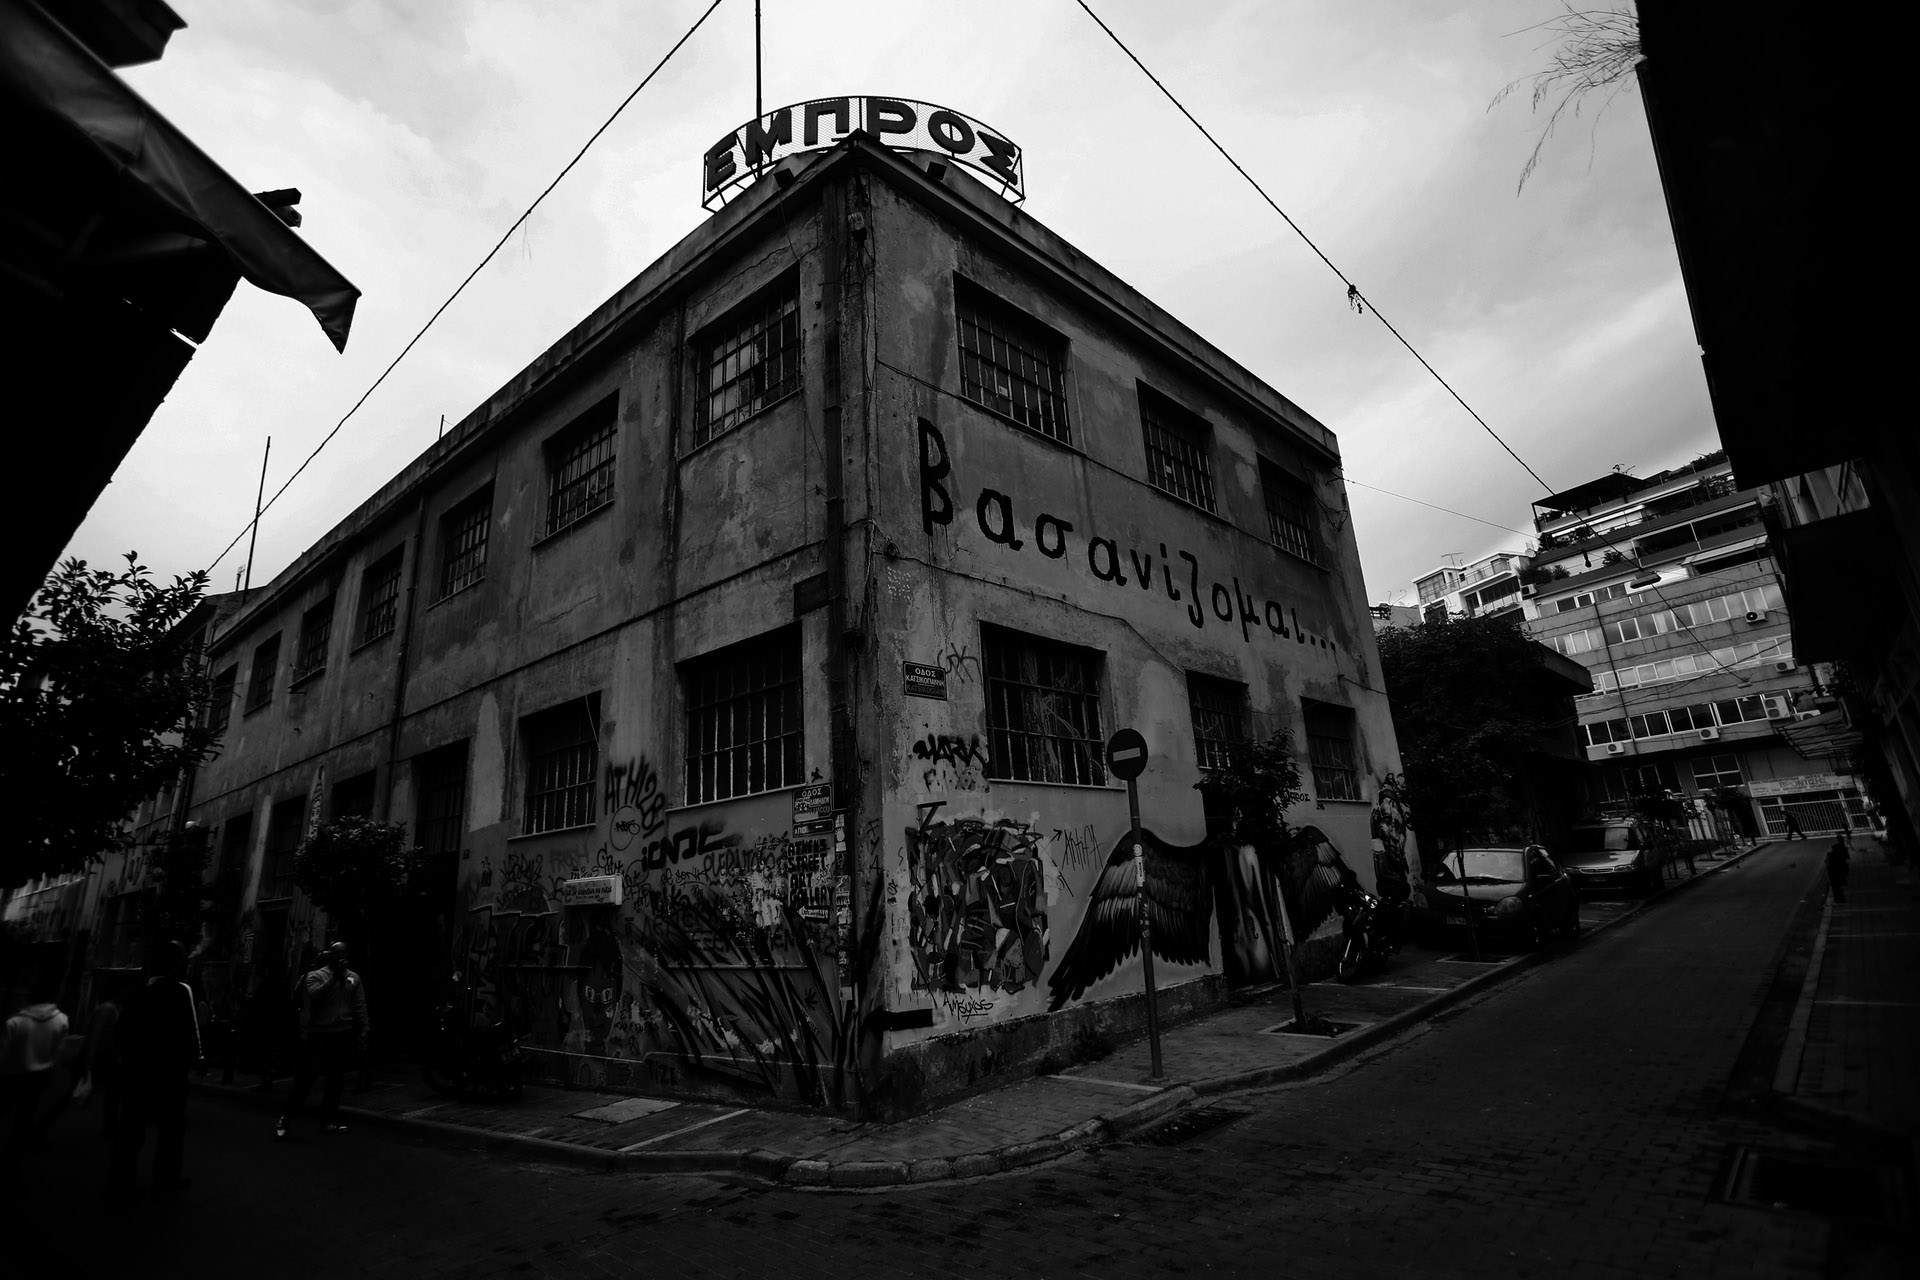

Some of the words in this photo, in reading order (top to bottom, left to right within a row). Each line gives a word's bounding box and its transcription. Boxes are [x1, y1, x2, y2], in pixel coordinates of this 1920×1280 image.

[706, 97, 1018, 192] ΕΜΠΡΟΣ
[914, 667, 937, 678] ΟΔΟΣ
[801, 788, 822, 797] ΟΔΟΣ
[787, 839, 827, 857] ATHENS
[787, 853, 828, 873] STREET
[790, 873, 814, 889] ART
